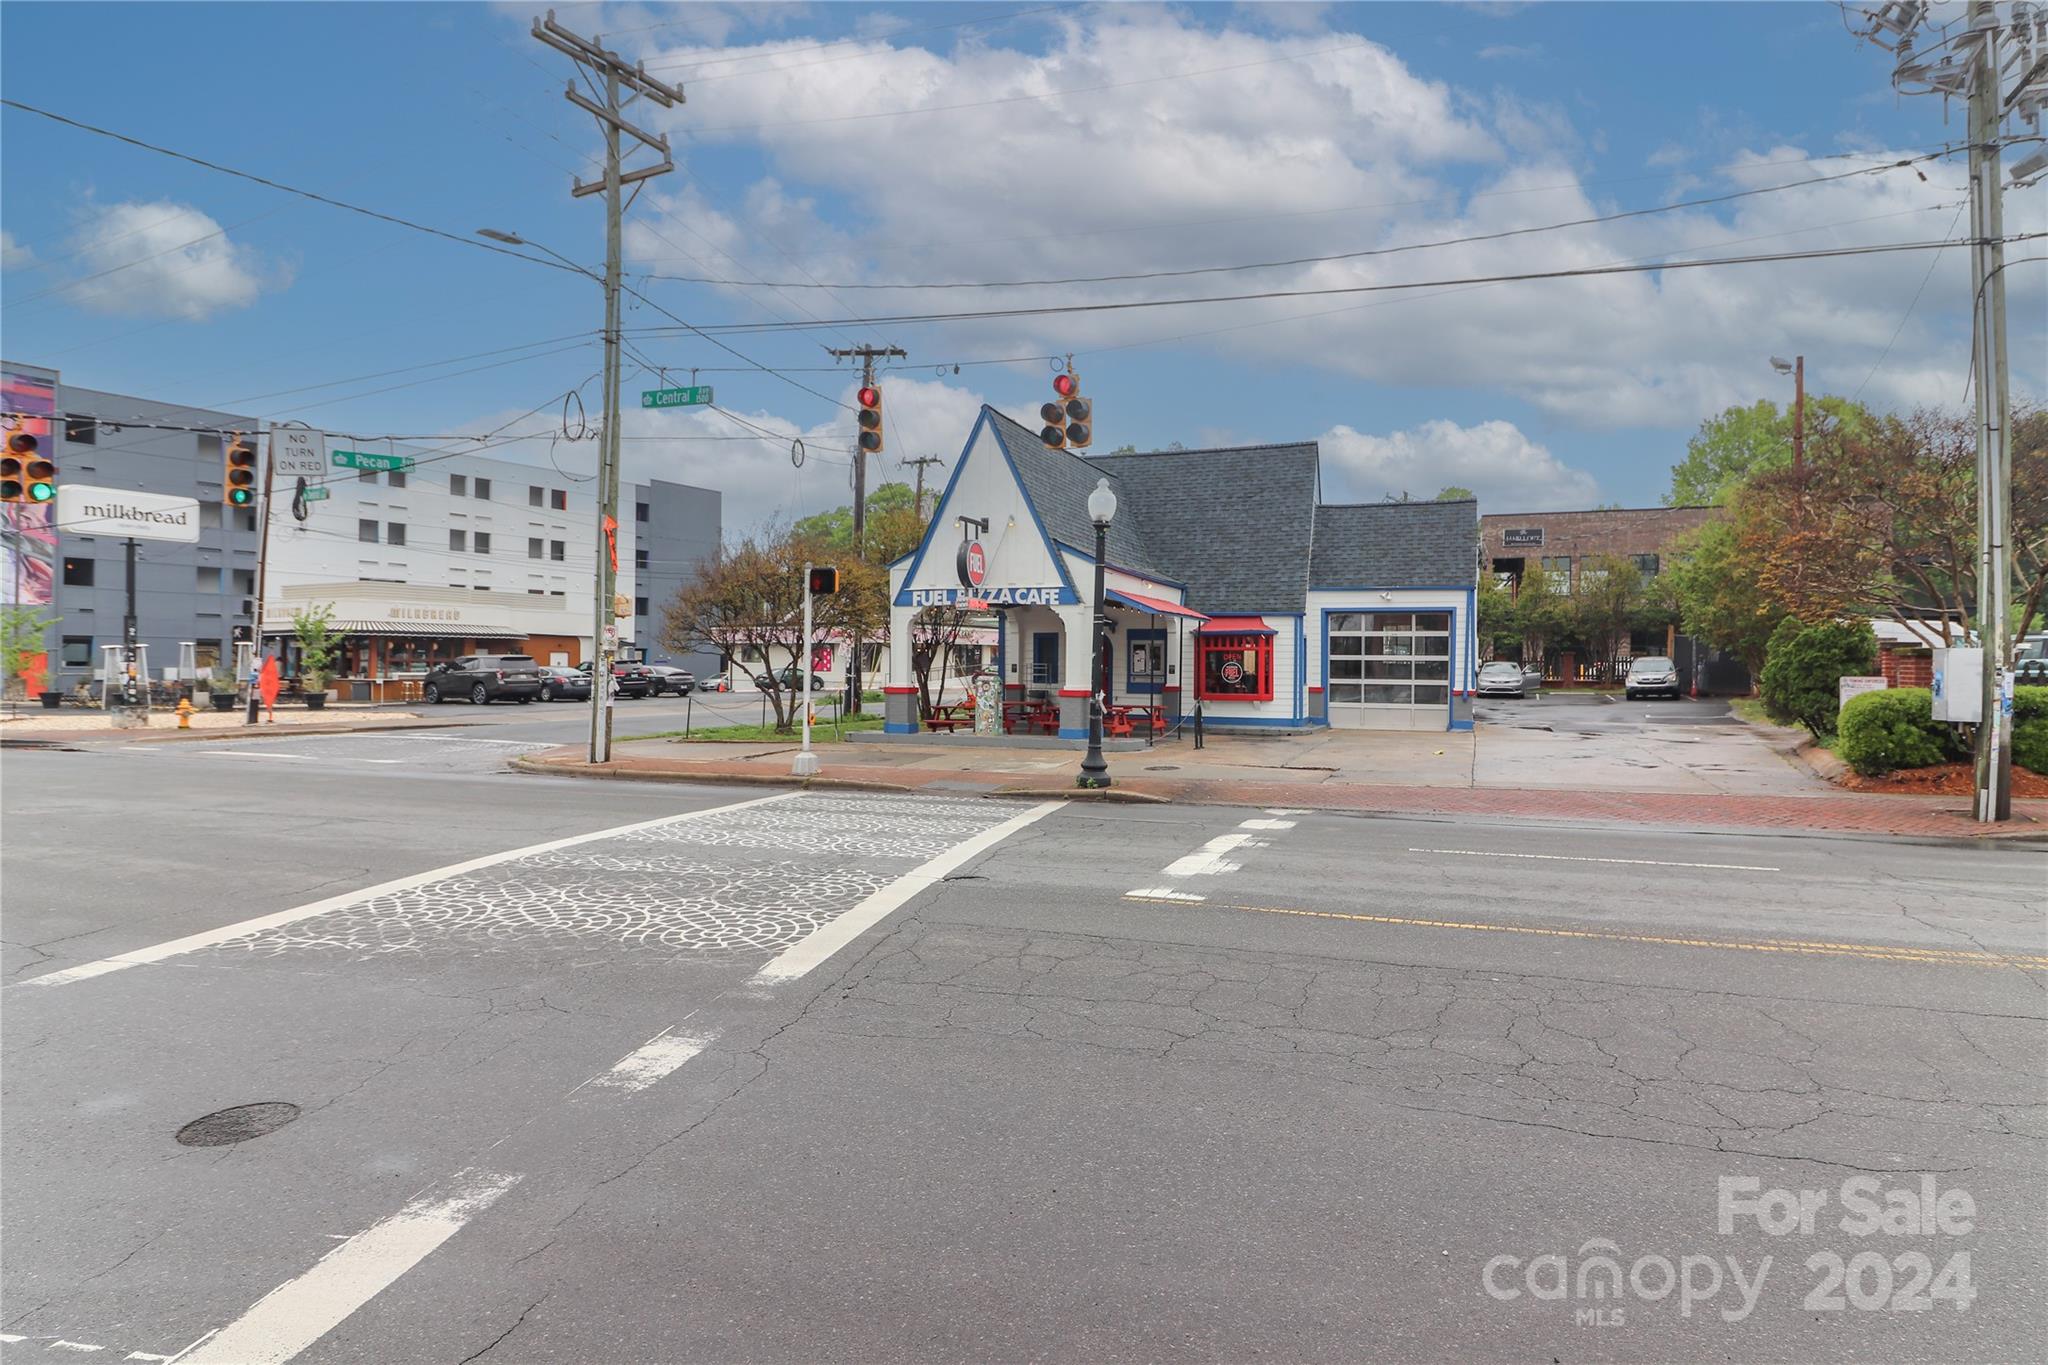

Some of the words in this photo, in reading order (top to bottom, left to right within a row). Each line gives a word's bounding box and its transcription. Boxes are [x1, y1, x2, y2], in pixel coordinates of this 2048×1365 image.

[656, 390, 690, 405] Central
[289, 434, 307, 444] NO
[285, 447, 315, 457] TURN
[280, 461, 296, 470] ON
[300, 461, 321, 471] RED
[355, 454, 391, 469] Pecan
[83, 503, 187, 525] milkbread
[970, 552, 984, 574] FUEL
[912, 589, 951, 606] FUEL
[1014, 588, 1060, 605] CAFE
[1223, 653, 1242, 661] OPEN
